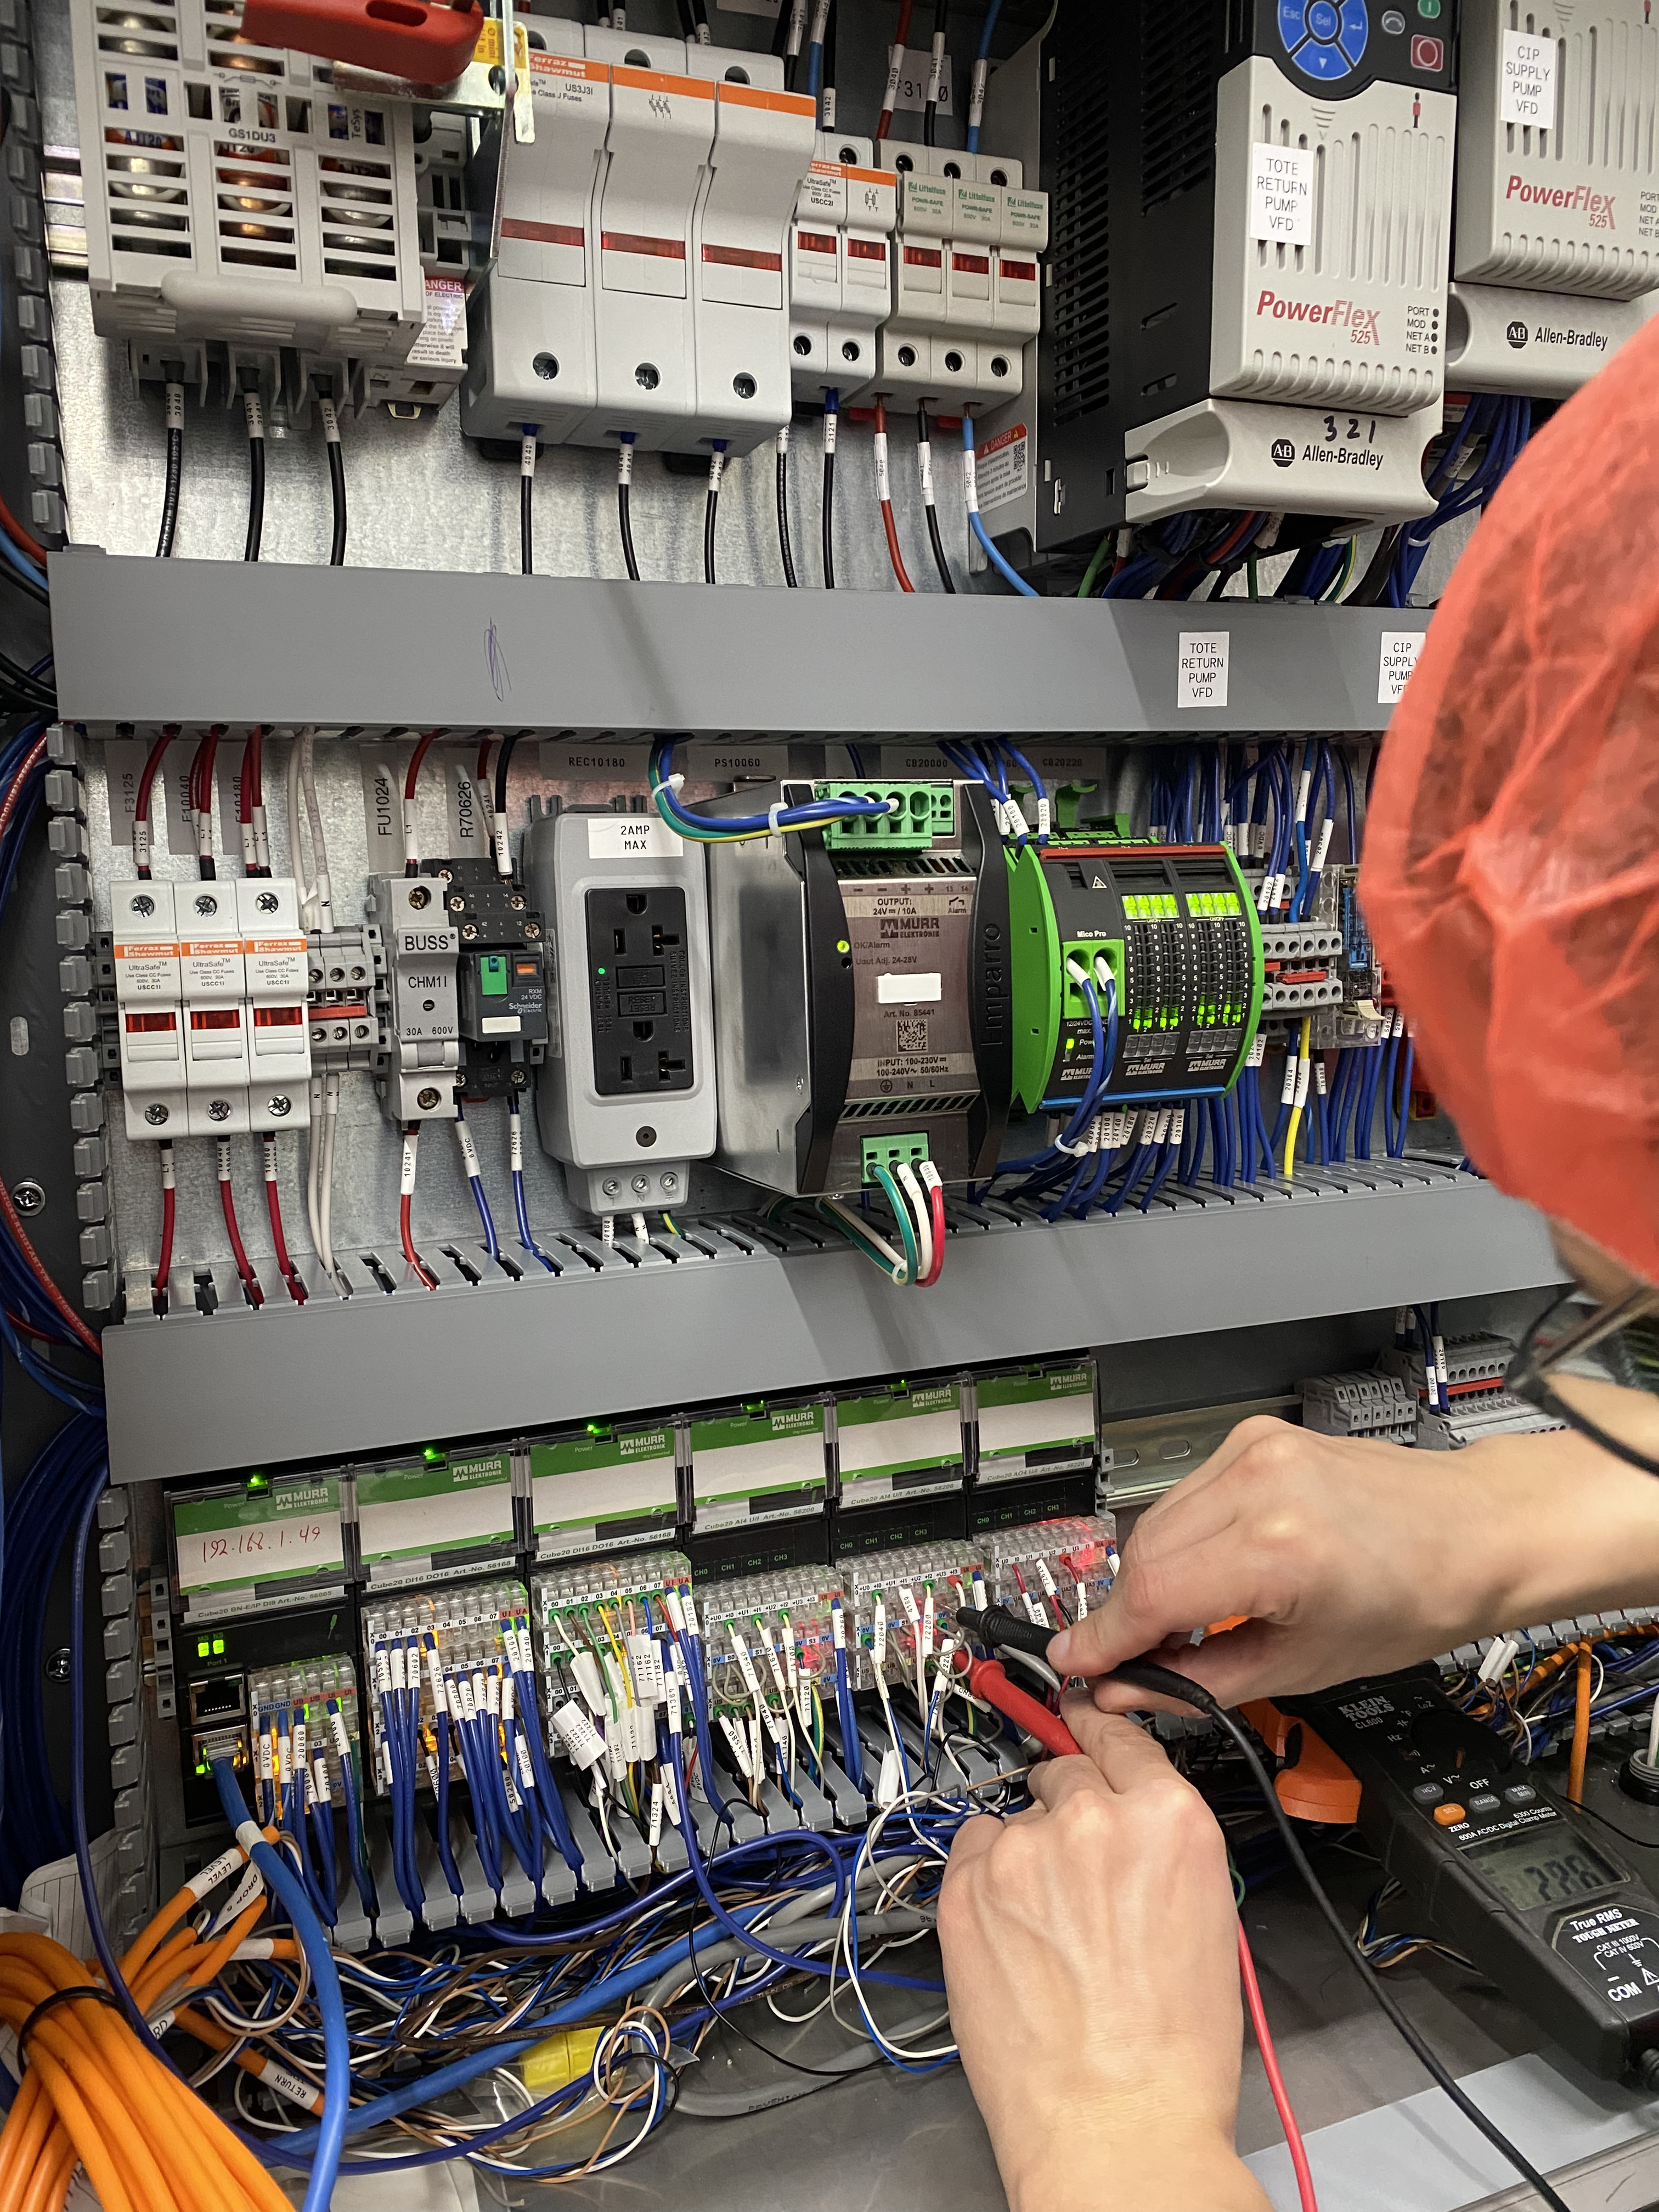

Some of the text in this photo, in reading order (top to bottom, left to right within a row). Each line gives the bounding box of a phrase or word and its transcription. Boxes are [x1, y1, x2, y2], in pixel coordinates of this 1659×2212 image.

[1283, 7, 1301, 20] Esc
[1316, 14, 1331, 26] Sel
[1517, 46, 1540, 60] CIP
[530, 63, 586, 77] Shawmut
[1506, 61, 1550, 81] SUPPLY
[897, 81, 948, 102] 310
[1513, 82, 1542, 97] PUMP
[1516, 99, 1538, 115] VFD
[229, 128, 276, 143] GS1DU3
[1266, 158, 1299, 175] TOTE
[919, 184, 946, 195] Littelfuse
[1257, 177, 1307, 196] RETURN
[912, 197, 944, 206] POWR-SAFE
[969, 193, 995, 202] Littelfuse
[1265, 196, 1298, 212] PUMP
[1506, 175, 1616, 229] PowerFlex
[962, 204, 992, 213] POWR-SAFE
[1640, 204, 1657, 213] MOD
[1011, 211, 1041, 221] POWR-SAFE
[1589, 214, 1607, 228] 525
[1639, 216, 1653, 225] NET
[1269, 216, 1294, 231] VFD
[1639, 227, 1652, 237] NET
[426, 279, 462, 291] ANGER
[1256, 290, 1380, 346] PowerFlex
[1407, 306, 1430, 317] PORT
[1407, 319, 1426, 329] MOD
[1351, 330, 1370, 345] 525
[1406, 331, 1430, 342] NET A
[1535, 326, 1608, 352] Allen-Bradley
[1406, 343, 1430, 354] NET B
[1302, 445, 1383, 470] Allen-Bradley
[1190, 643, 1217, 654] TOTE
[1393, 643, 1412, 653] CIP
[1182, 658, 1224, 669] RETURN
[1189, 673, 1216, 683] PUMP
[1192, 688, 1212, 698] VFD
[569, 757, 625, 768] REC10180
[715, 758, 760, 768] PS10060
[906, 759, 947, 768] CB20000
[125, 773, 133, 812] F3125
[180, 775, 190, 822] F10040
[375, 777, 392, 836] FU1024
[458, 781, 473, 837] R70626
[1009, 805, 1022, 828] 20100
[405, 825, 412, 834] L1
[620, 826, 650, 835] 2AMP
[624, 840, 647, 850] MAX
[1263, 882, 1272, 904] 20182
[900, 918, 939, 929] MURR
[405, 935, 448, 951] BUSS
[878, 1057, 938, 1067] INPUT: 100-230V
[1113, 1118, 1121, 1142] 20140
[1122, 1116, 1135, 1139] 20180
[1146, 1116, 1155, 1139] 20220
[635, 1435, 665, 1447] MURR
[470, 1460, 501, 1473] MURR
[470, 1470, 502, 1480] ELEKTRONIK
[294, 1487, 329, 1500] MURR
[294, 1497, 329, 1508] ELEKTRONIK
[540, 1532, 671, 1559] Cube20 DI16 DO16 Art.-No. 56168
[371, 1560, 511, 1590] Cube20 DI16 DO16 Art.-No. 56168
[523, 1637, 532, 1663] 20140
[466, 1688, 474, 1712] 70820
[1338, 1695, 1391, 1714] KLEIN
[258, 1704, 274, 1712] GND
[1346, 1703, 1395, 1721] TOOLS
[1355, 1717, 1383, 1729] CL800
[1469, 1779, 1489, 1789] OFF
[1475, 1796, 1497, 1806] RANGE
[1530, 1806, 1552, 1815] Counts
[1448, 1822, 1470, 1833] ZERO
[1459, 1811, 1557, 1841] 600A AC/DC Digital Clamp Meter
[208, 1862, 232, 1884] LEVEL
[236, 1874, 258, 1905] DROP
[1570, 1909, 1622, 1931] True RMS
[1572, 1918, 1640, 1943] TOUGH METER
[1607, 1982, 1642, 2001] COM
[274, 2074, 306, 2098] RETURN
